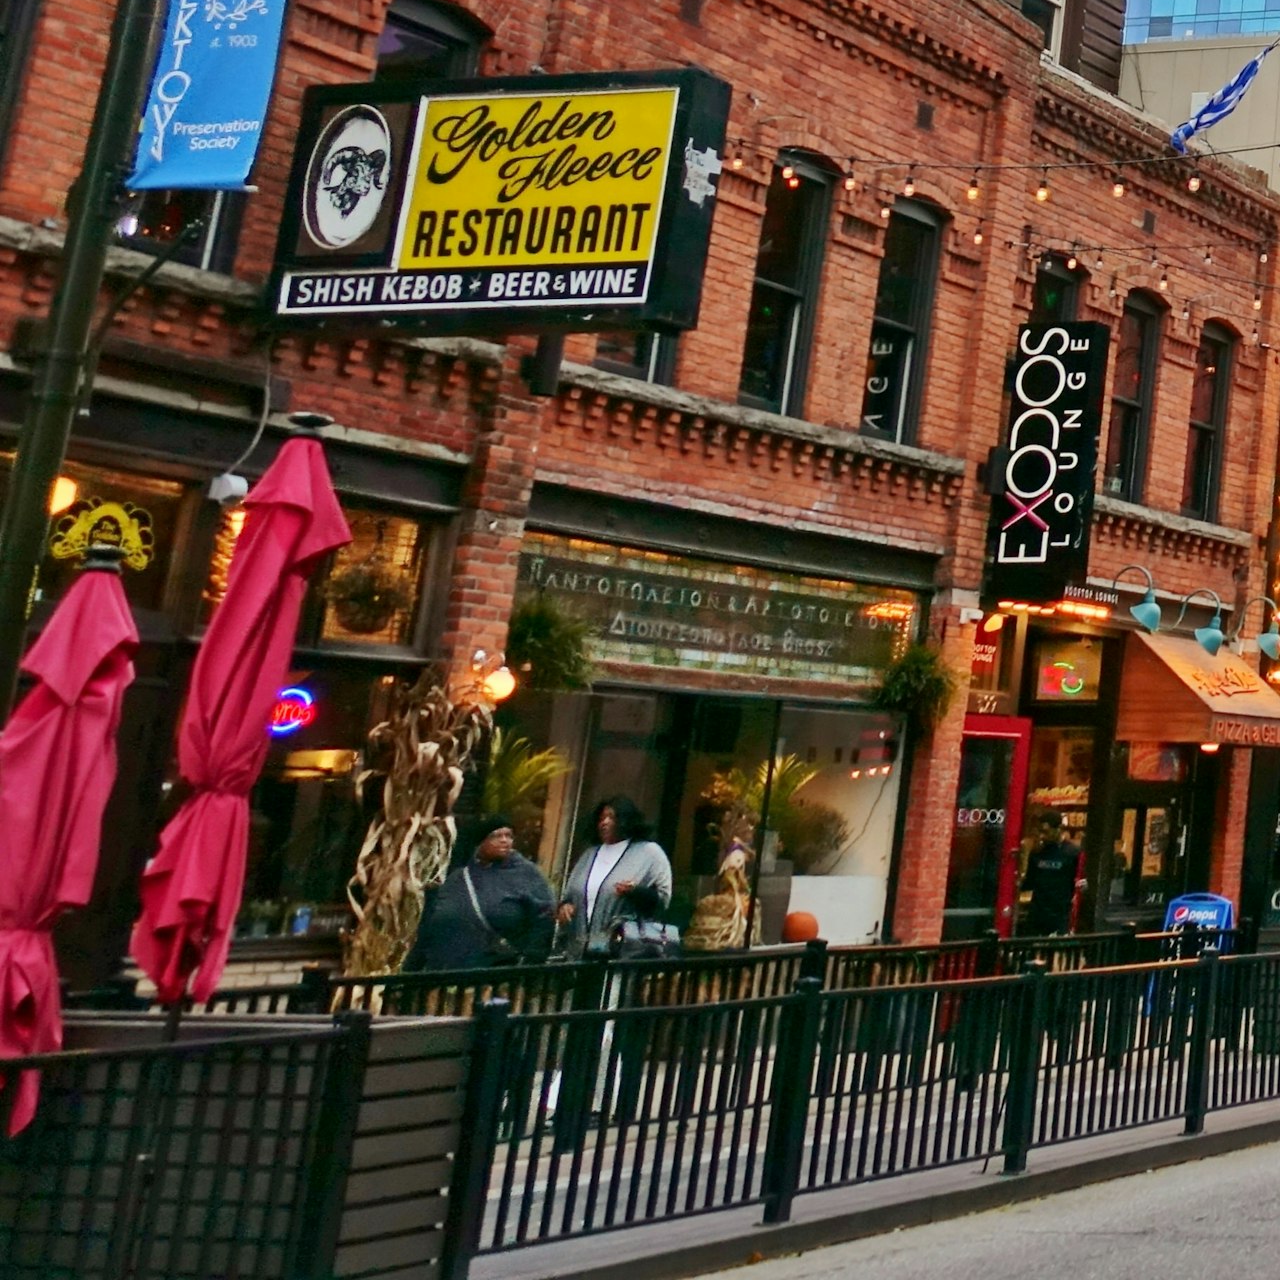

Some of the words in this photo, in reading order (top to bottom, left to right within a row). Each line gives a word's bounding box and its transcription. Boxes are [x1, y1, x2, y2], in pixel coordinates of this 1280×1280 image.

[172, 118, 260, 136] Preservation
[189, 134, 241, 151] Society
[427, 100, 616, 184] Golden
[497, 142, 662, 204] Fleece
[411, 203, 651, 259] RESTAURANT
[296, 276, 372, 304] SHISH
[380, 273, 463, 301] KEBOB
[997, 327, 1070, 563] EXODOS
[1050, 337, 1089, 547] LOUNGE
[1216, 721, 1250, 742] PIZZA
[957, 808, 1005, 824] EXODOS
[1188, 909, 1218, 922] pepsi
